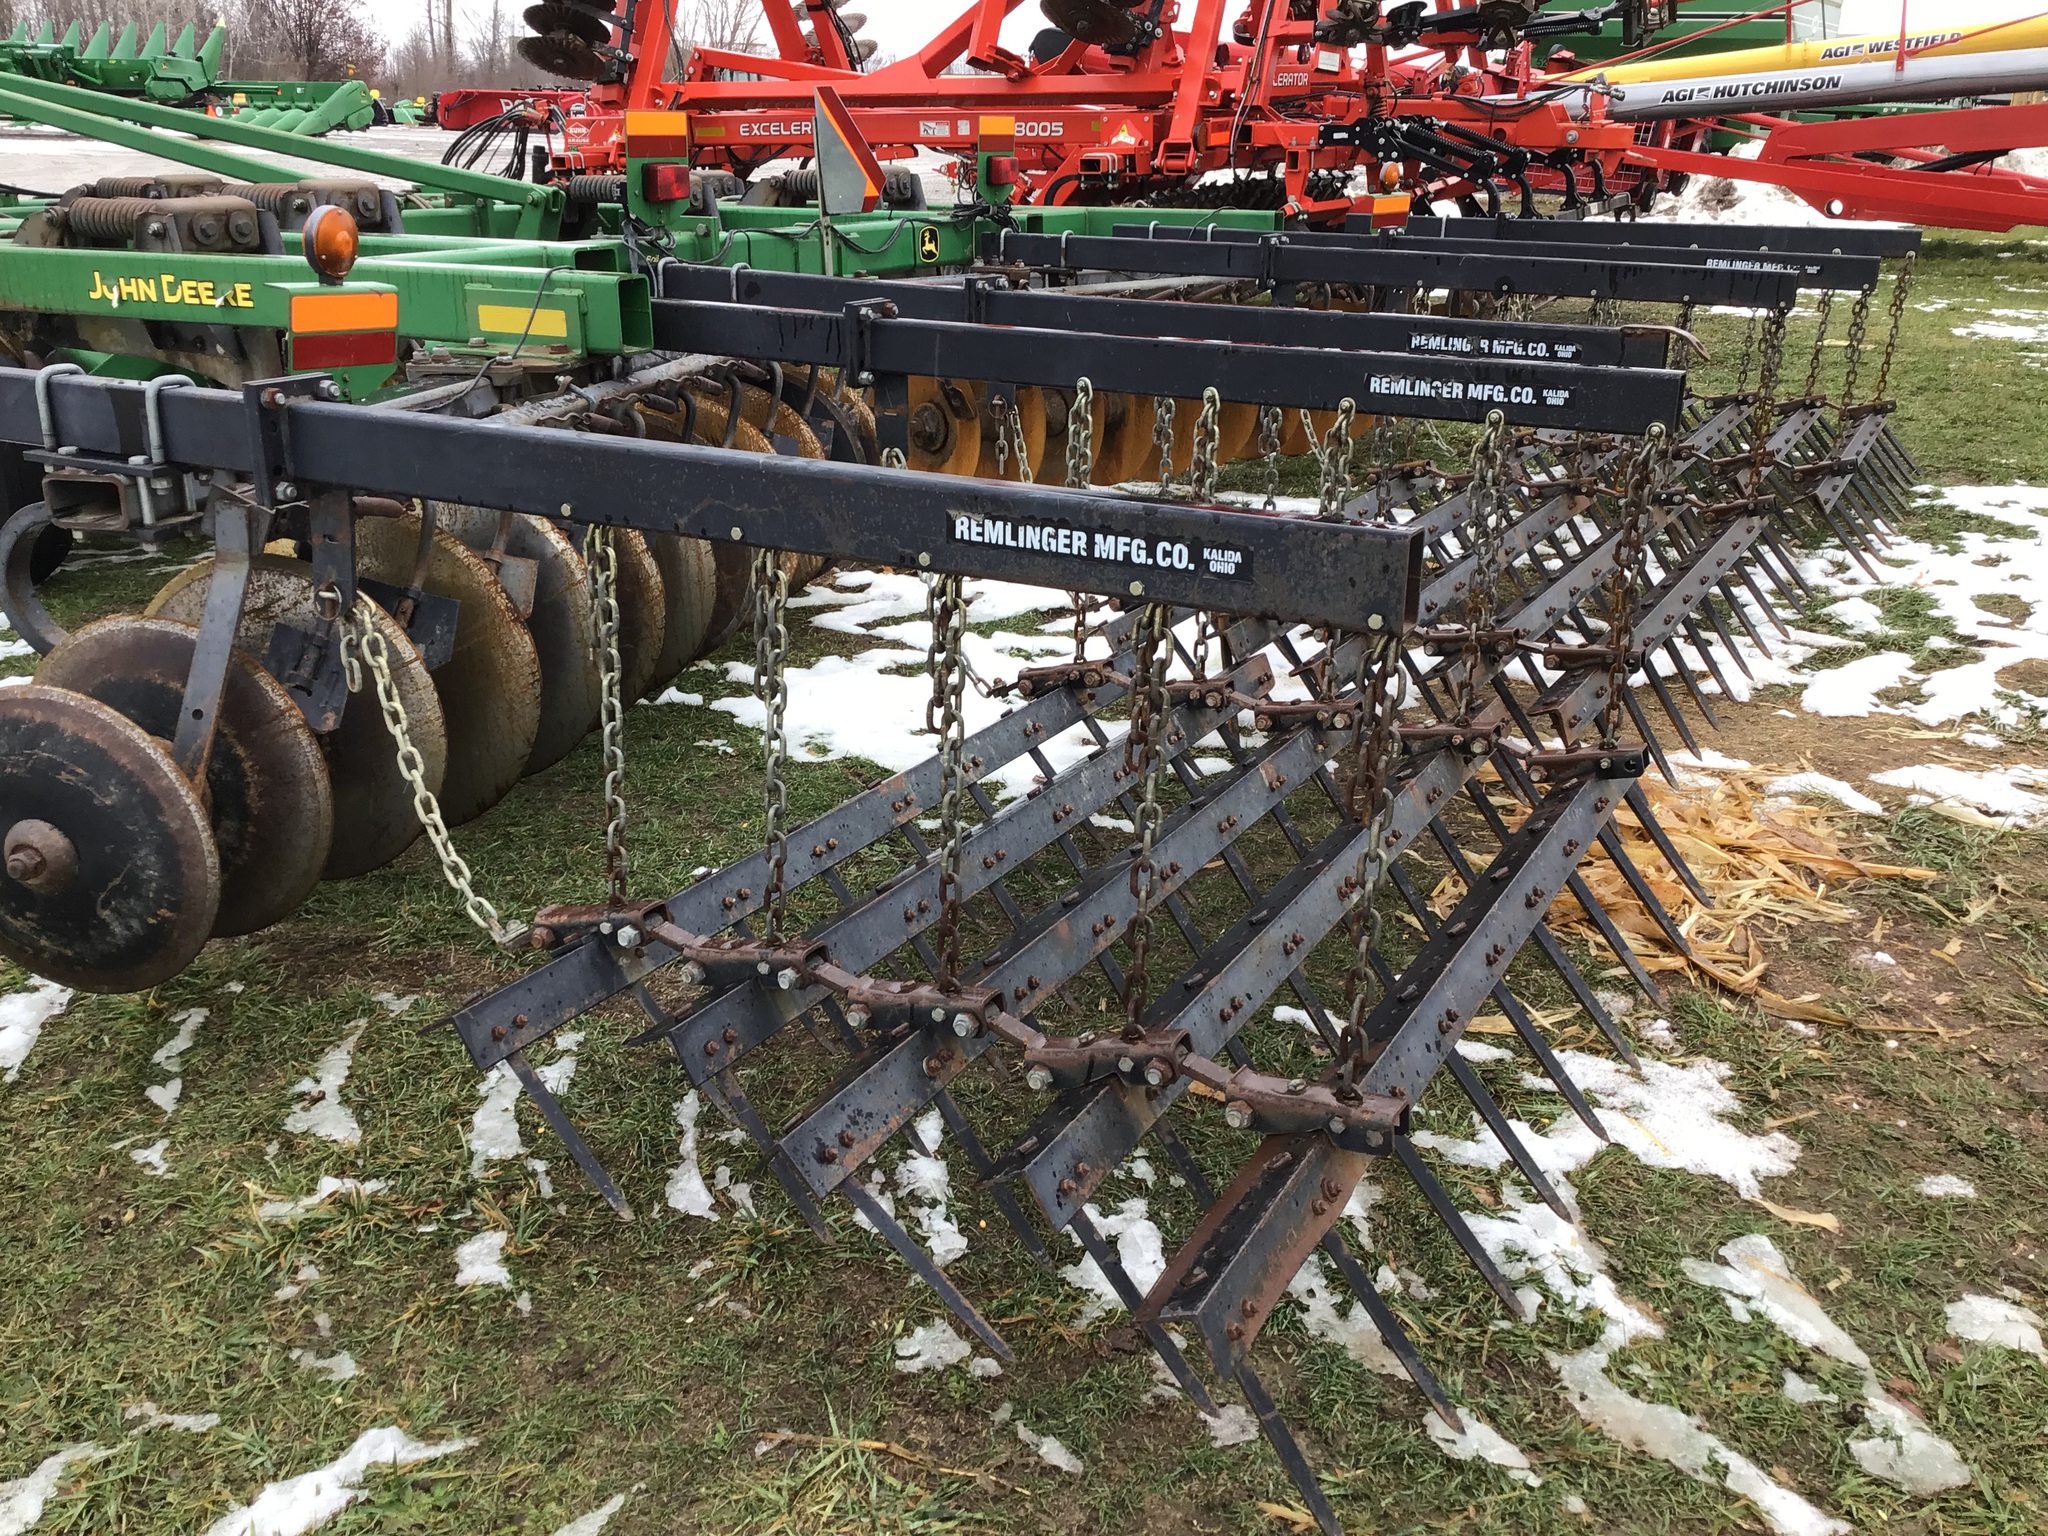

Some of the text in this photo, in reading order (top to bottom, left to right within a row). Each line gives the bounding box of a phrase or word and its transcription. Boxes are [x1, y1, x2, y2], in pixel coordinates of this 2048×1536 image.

[1821, 45, 1850, 59] AGI
[1661, 75, 1842, 103] AGI HUTCHINSON
[740, 122, 812, 136] EXCELER
[1014, 121, 1064, 137] 8005
[1411, 335, 1550, 357] REMLINGR MFG. CO.
[1554, 343, 1577, 352] KALIDA
[1557, 350, 1573, 358] OHIO
[1467, 383, 1508, 402] MFG.
[1510, 386, 1537, 404] CO.
[1542, 388, 1569, 398] KALIDA
[1546, 396, 1565, 406] OHIO
[955, 516, 1195, 571] REMLINGER MFG. CO.
[1203, 548, 1242, 564] KALIDA
[1209, 560, 1235, 575] OHIO
